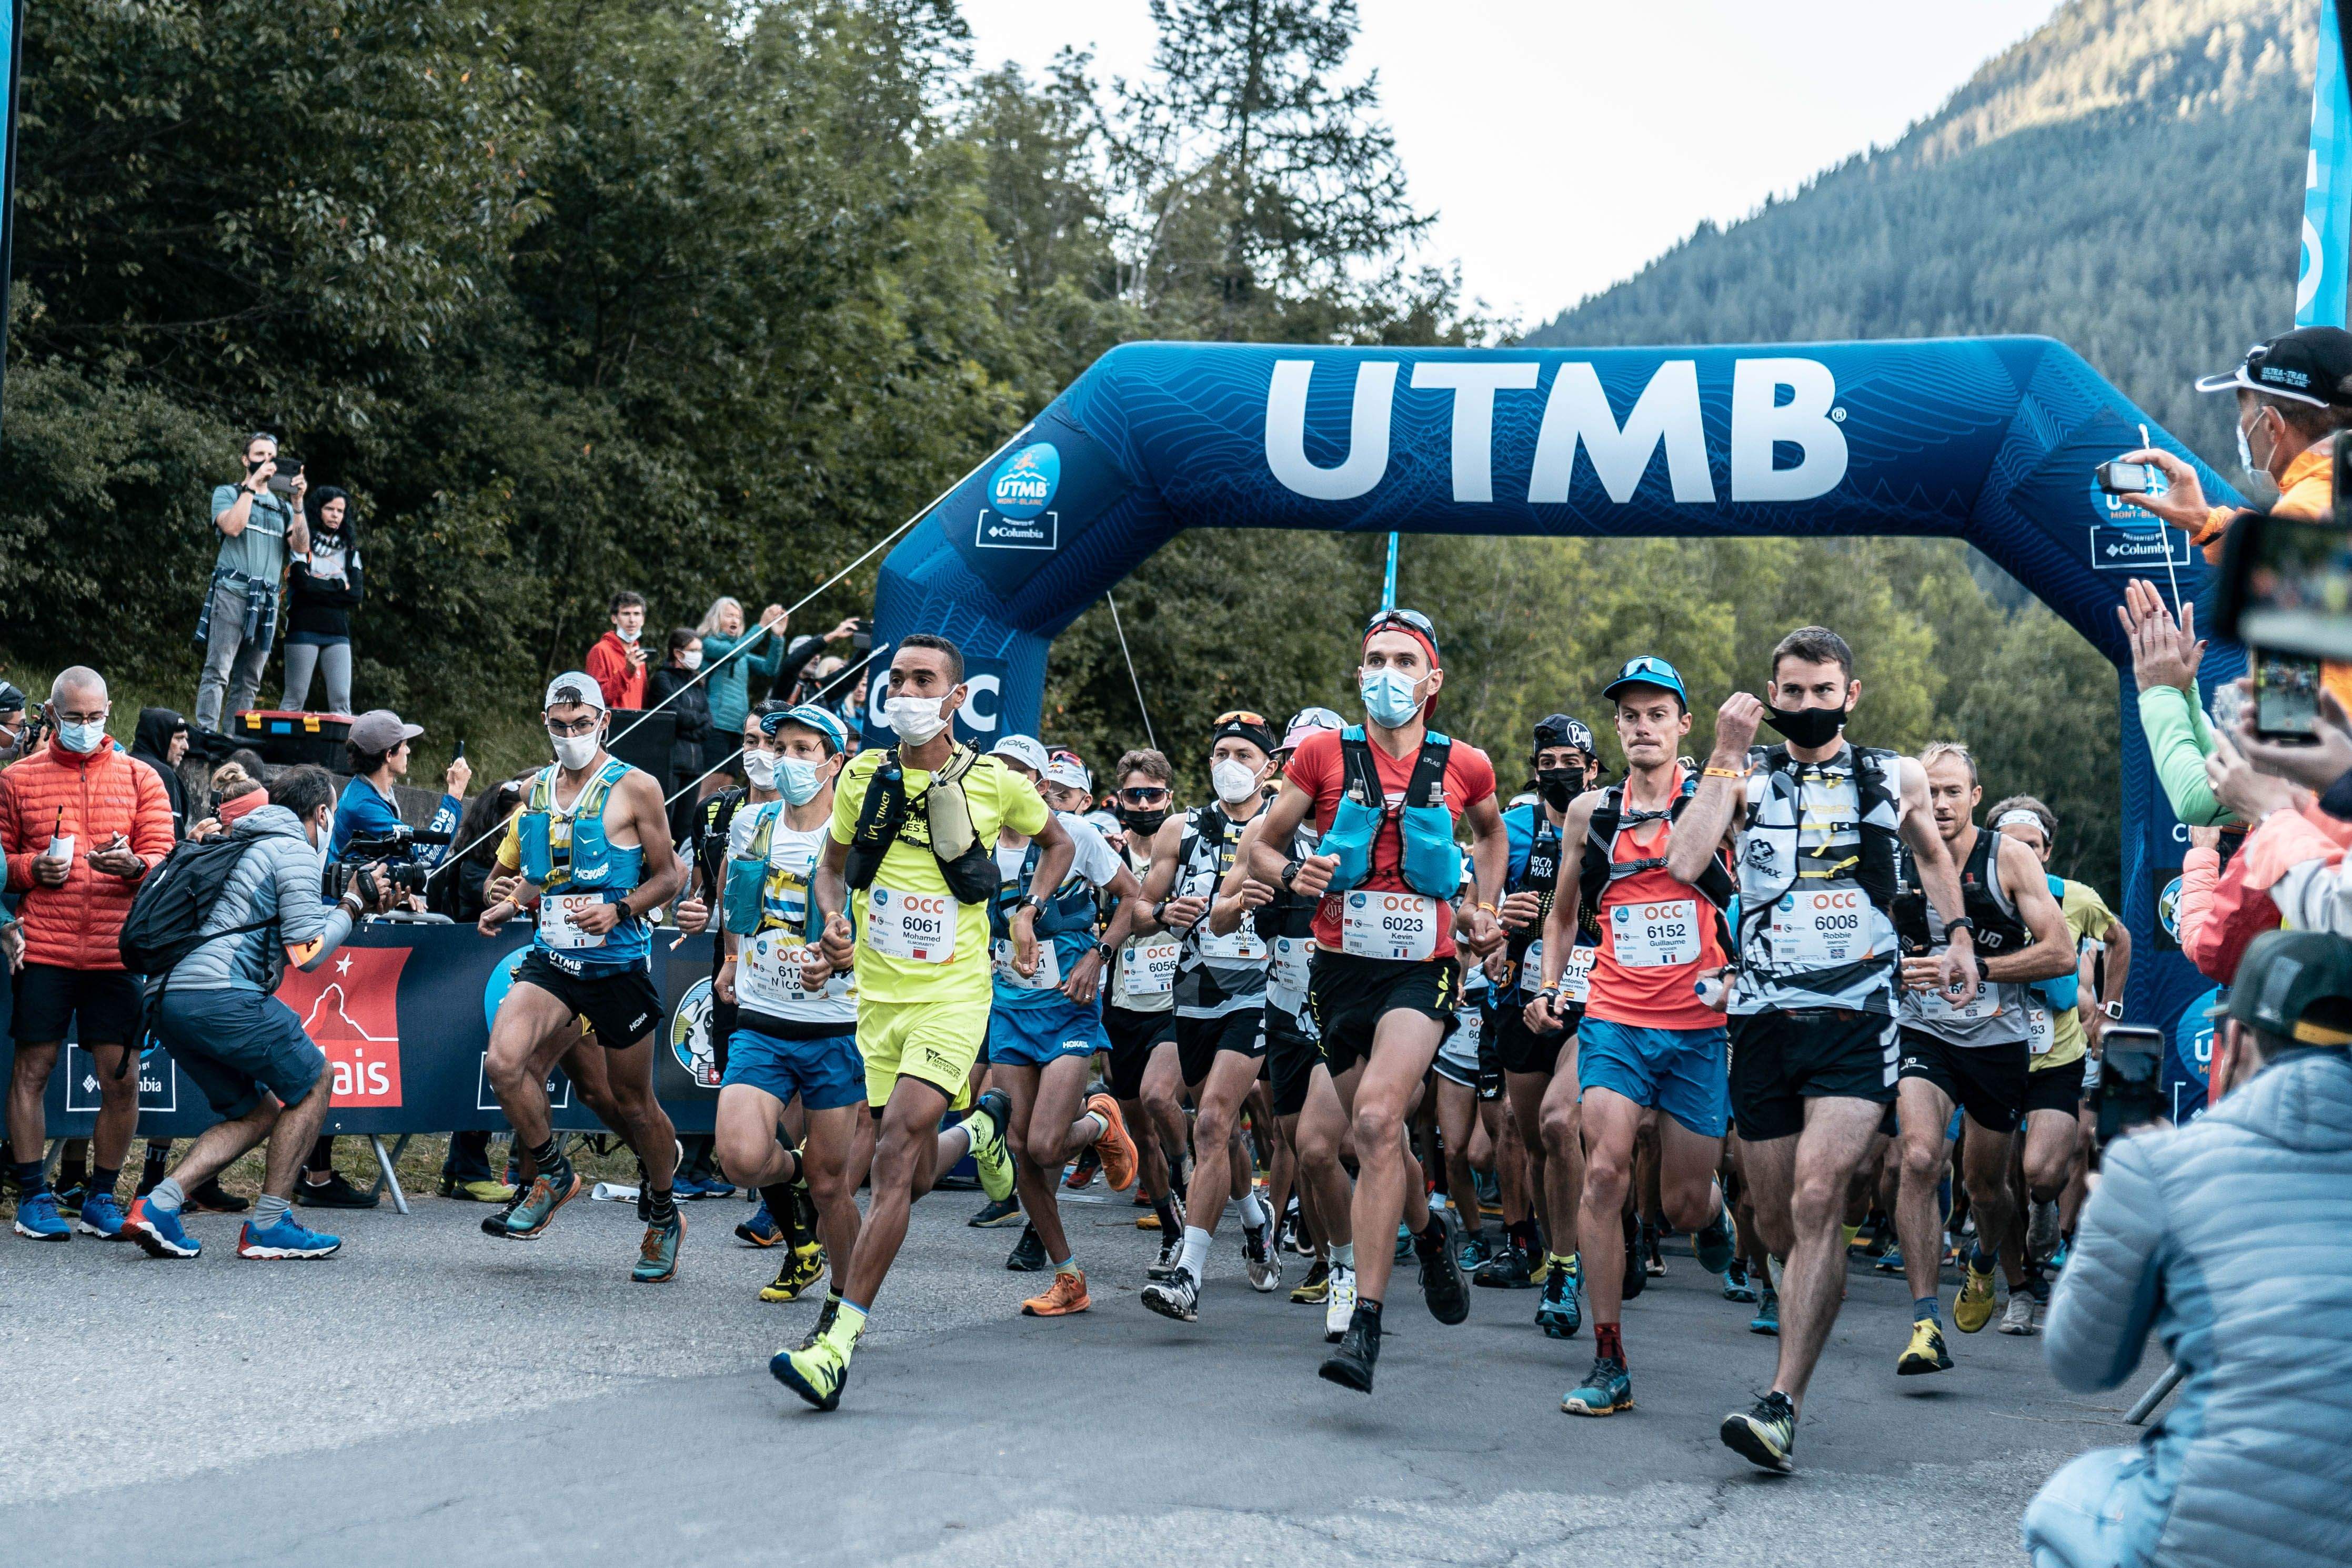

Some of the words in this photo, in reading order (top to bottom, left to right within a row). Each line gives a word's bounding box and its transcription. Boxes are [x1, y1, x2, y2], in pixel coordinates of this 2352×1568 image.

[996, 481, 1047, 497] UTMB
[999, 527, 1044, 539] Columbia
[2123, 532, 2154, 541] PRESENTED
[2119, 542, 2174, 556] Columba
[999, 739, 1031, 753] HOKA
[1530, 866, 1553, 878] MAX
[903, 896, 944, 914] OCC
[1384, 896, 1424, 913] OCC
[1813, 893, 1856, 910] OCC
[1644, 904, 1683, 920] OCC
[902, 916, 941, 933] 6061
[1382, 916, 1424, 932] 6023
[1815, 914, 1858, 930] 6008
[903, 931, 941, 942] Mohamed
[1647, 923, 1686, 939] 6152
[777, 949, 811, 963] OCC
[1147, 946, 1175, 959] OCC
[1573, 949, 1592, 962] CC
[549, 960, 580, 977] MONT-BLANC
[778, 966, 801, 979] 617
[1149, 960, 1177, 972] 6056
[1565, 965, 1590, 978] 015
[629, 1012, 648, 1032] HOKA
[142, 1061, 150, 1071] BY
[318, 1045, 390, 1095] ais
